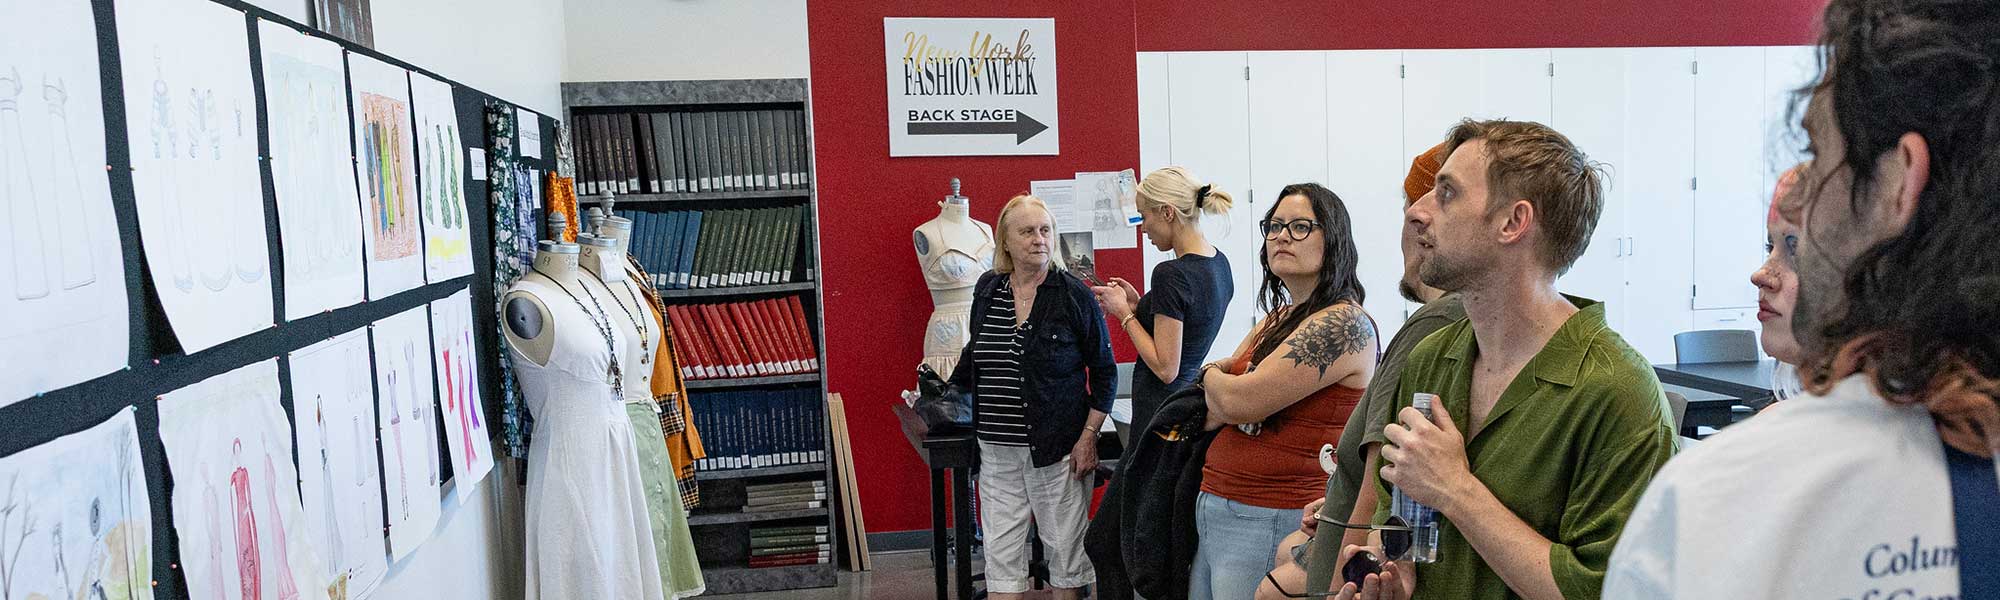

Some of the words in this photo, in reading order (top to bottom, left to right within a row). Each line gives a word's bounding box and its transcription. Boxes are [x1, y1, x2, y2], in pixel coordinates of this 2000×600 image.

[904, 31, 962, 72] New
[969, 29, 1033, 77] York
[903, 57, 981, 96] FASHION
[984, 57, 1038, 96] WEEK
[908, 109, 955, 121] BACK
[961, 109, 1014, 121] STAGE
